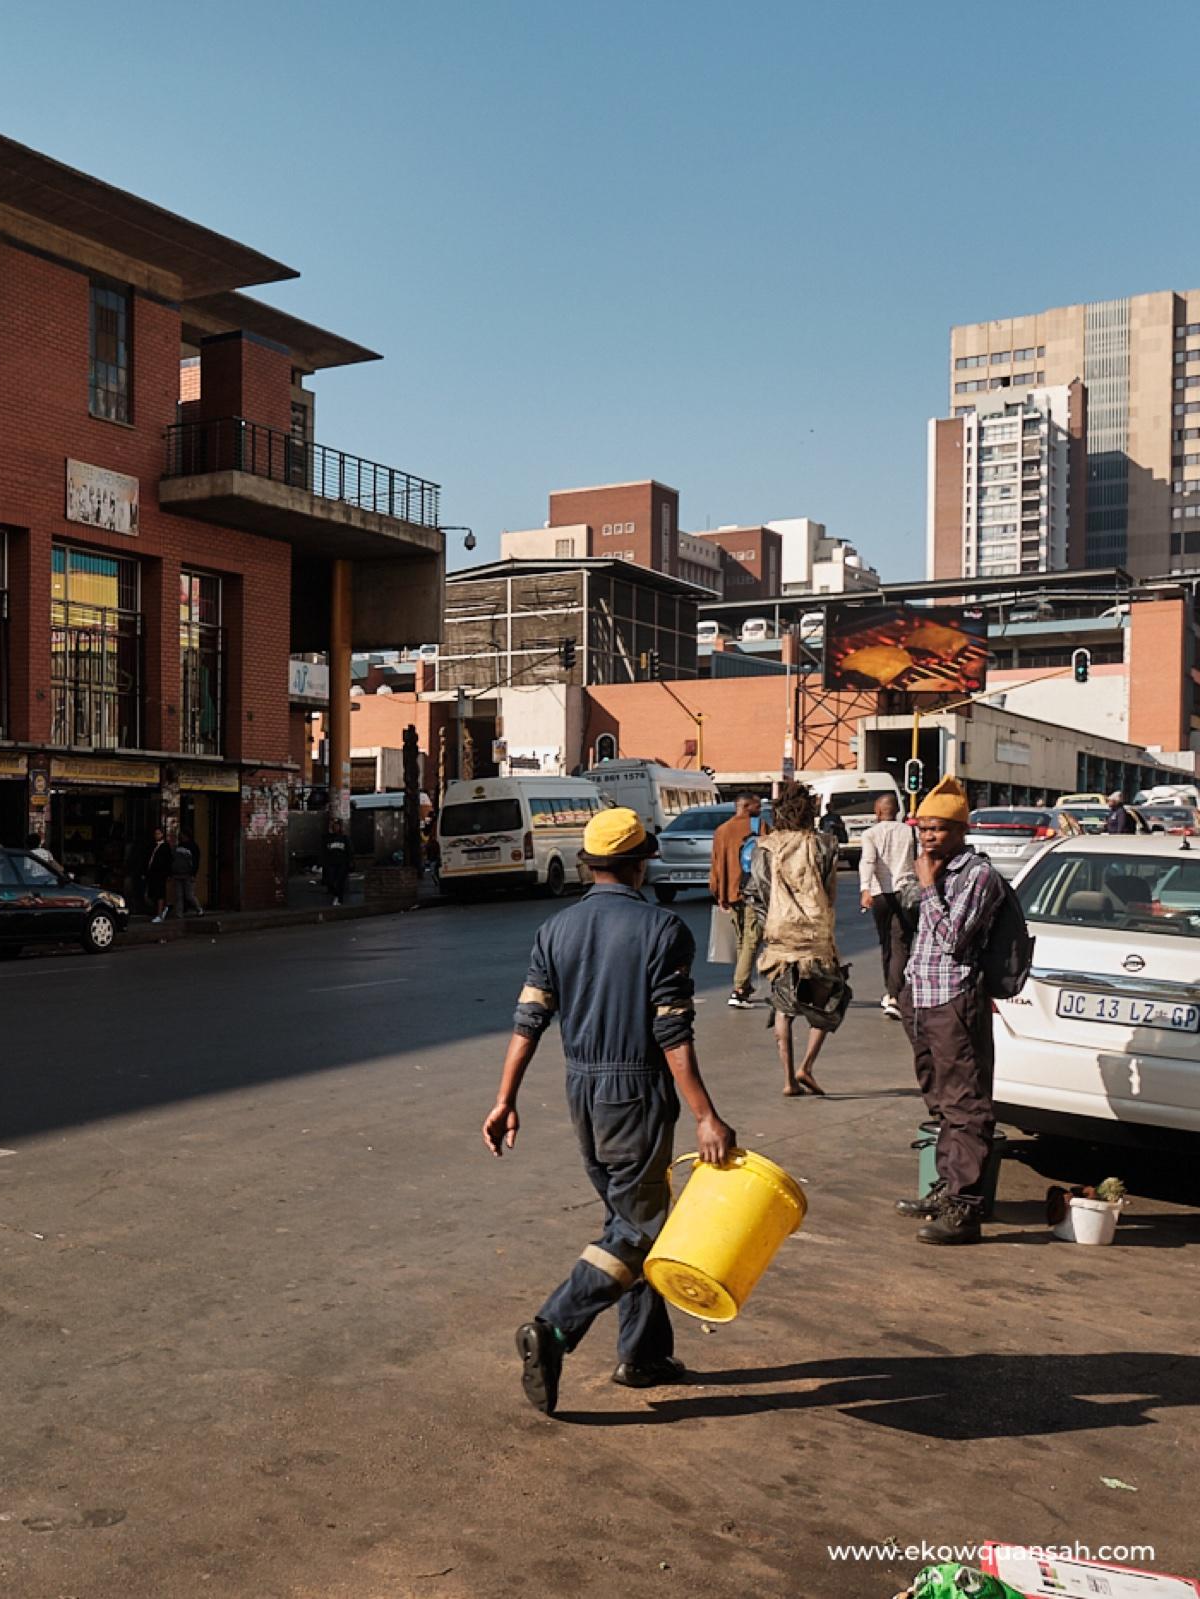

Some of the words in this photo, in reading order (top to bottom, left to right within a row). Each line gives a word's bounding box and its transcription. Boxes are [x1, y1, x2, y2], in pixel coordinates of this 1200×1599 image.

[1063, 995, 1085, 1014] JC
[1096, 998, 1120, 1018] 13
[1130, 1002, 1154, 1023] LZ
[1171, 1005, 1196, 1027] GP
